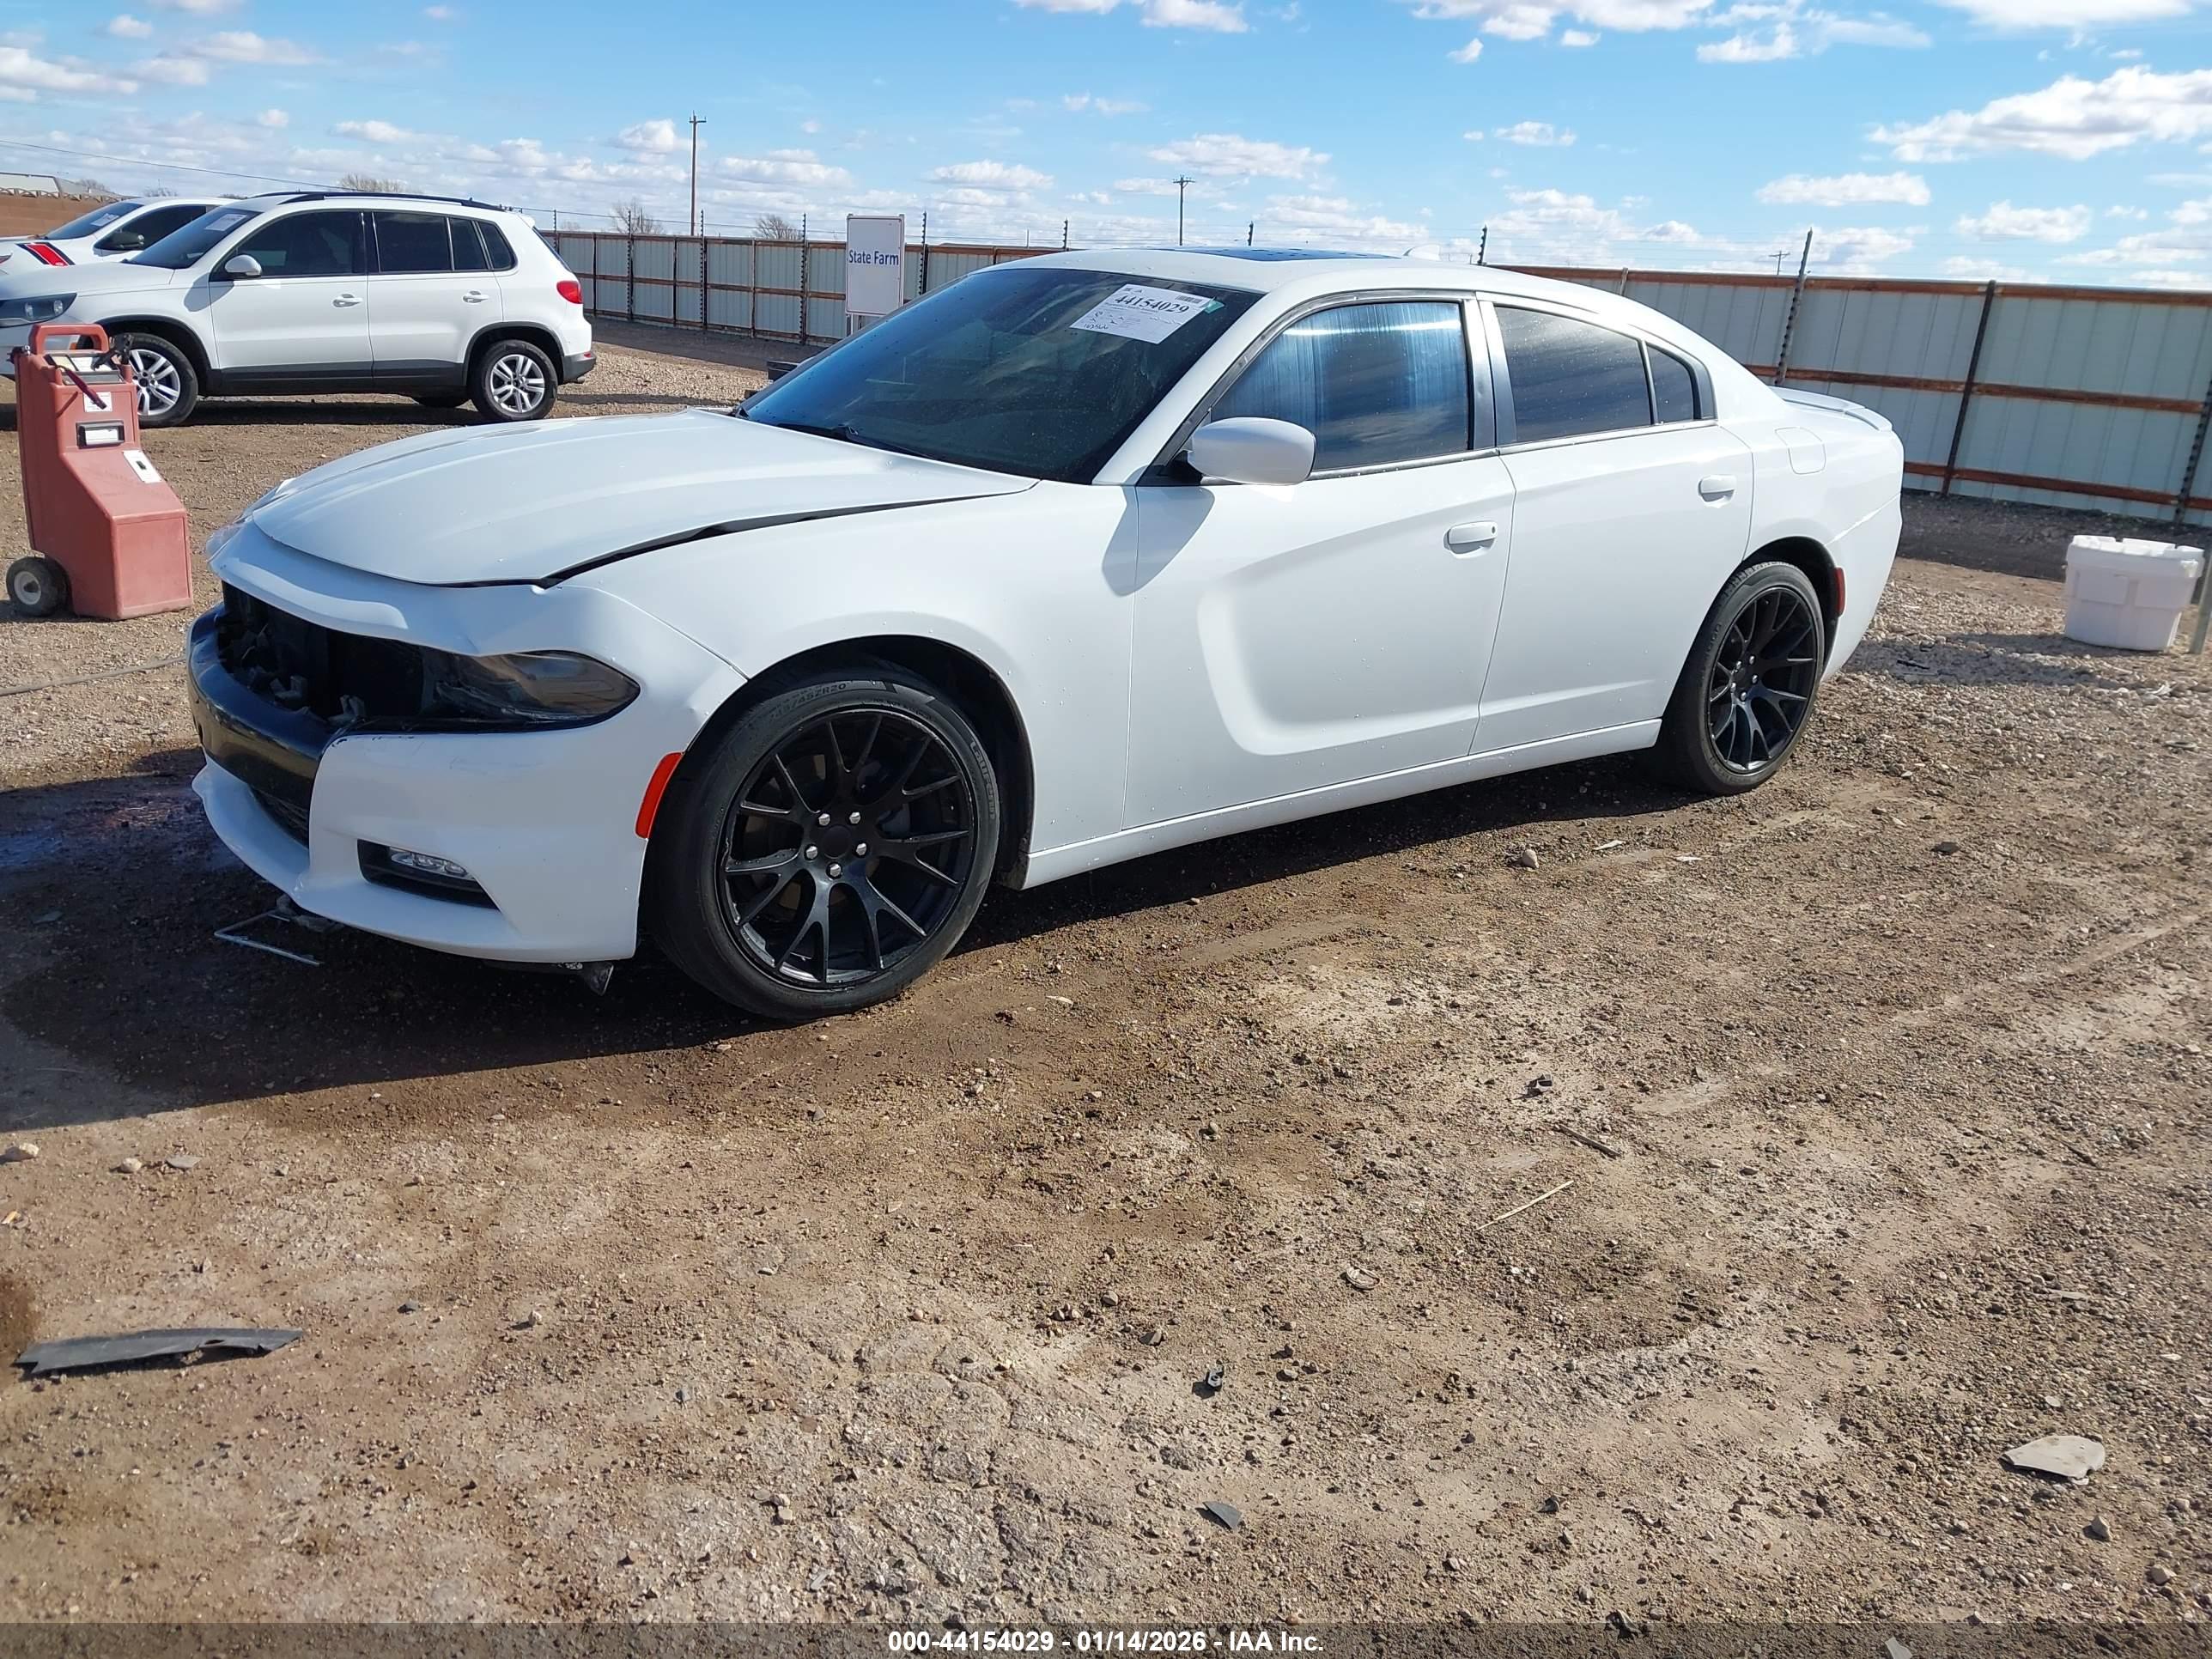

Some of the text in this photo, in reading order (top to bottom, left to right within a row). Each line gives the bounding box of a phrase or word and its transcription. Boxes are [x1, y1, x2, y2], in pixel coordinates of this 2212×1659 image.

[848, 249, 899, 266] State Farm
[1114, 295, 1189, 314] 44154029
